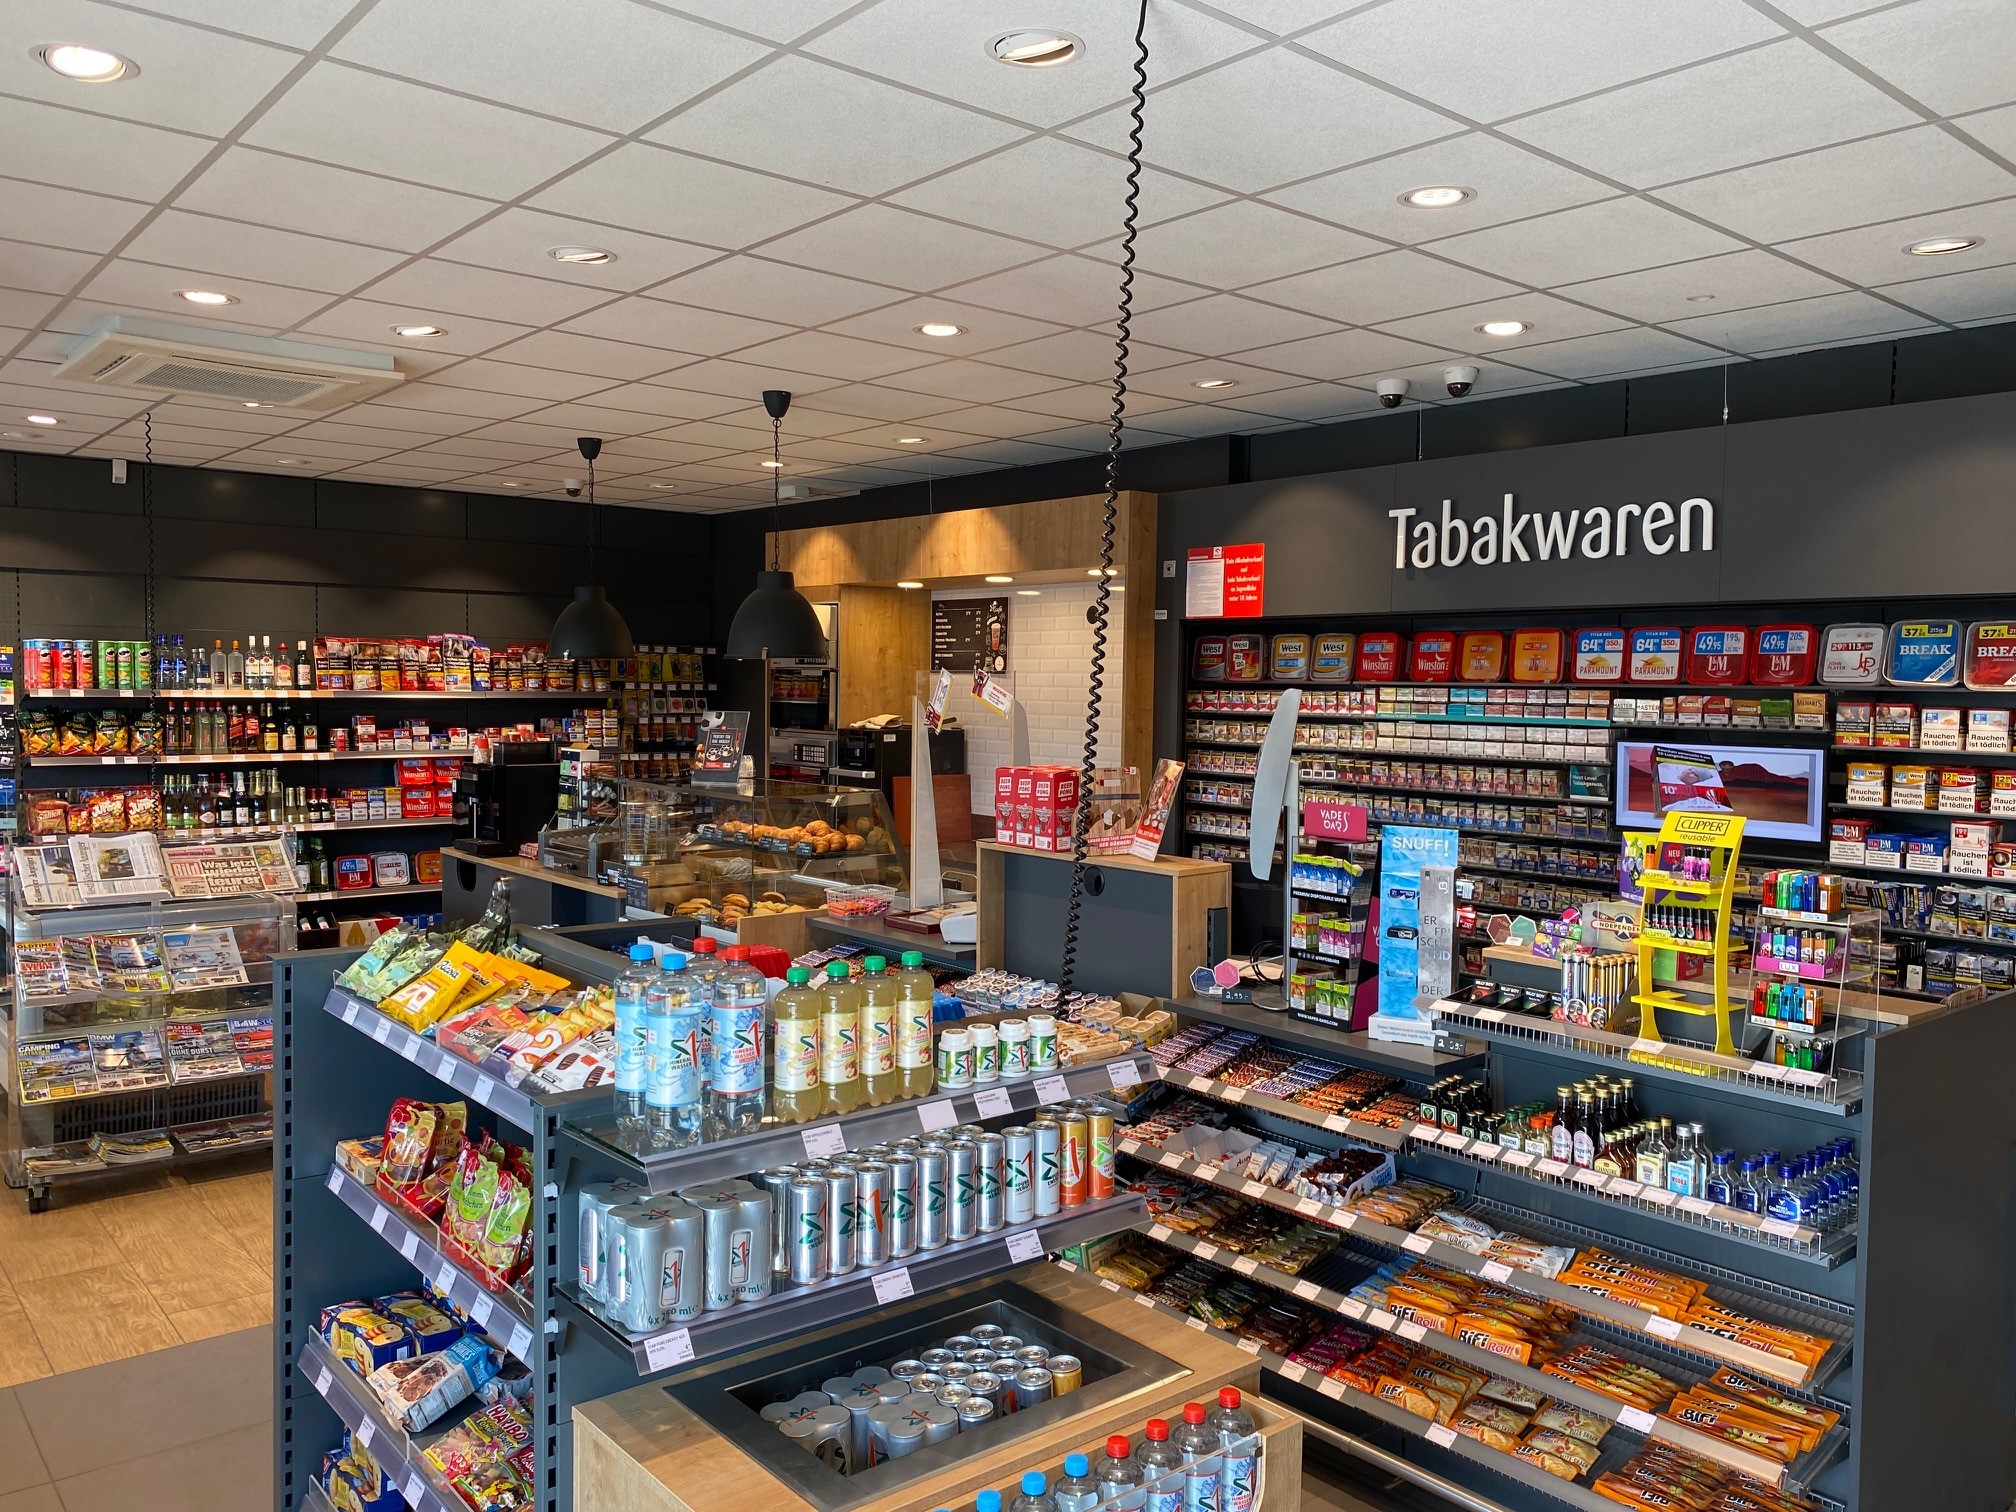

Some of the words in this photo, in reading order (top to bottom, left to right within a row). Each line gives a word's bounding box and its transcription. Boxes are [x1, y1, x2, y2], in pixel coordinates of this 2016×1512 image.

[1388, 493, 1714, 569] Tabakwaren
[1203, 645, 1221, 653] West
[1281, 643, 1302, 652] West
[1322, 643, 1344, 652] West
[1899, 644, 1952, 655] BREAK
[1362, 659, 1389, 670] Winston
[1418, 658, 1445, 670] Winston
[1707, 655, 1727, 671] L&M
[1771, 654, 1790, 671] L&M
[1580, 666, 1618, 675] PARAMOUNT
[1635, 666, 1674, 676] PARAMOUNT
[1929, 668, 1943, 680] GIGA
[1942, 658, 1954, 671] BOX
[1923, 732, 1956, 740] Rauchen
[1971, 734, 2005, 742] Rauchen
[1931, 739, 1957, 747] tödlich
[1979, 741, 2007, 749] tödlich
[403, 770, 427, 778] Winston
[437, 769, 461, 777] Winston
[1060, 781, 1073, 789] BEER
[1060, 788, 1073, 796] PONG
[1850, 788, 1881, 796] Rauchen
[1894, 791, 1922, 799] Rauchen
[1858, 795, 1882, 803] tödlich
[1901, 798, 1923, 806] tödlich
[1941, 794, 1972, 802] Rauchen
[406, 802, 429, 811] Winston
[1949, 801, 1974, 809] tödlich
[1681, 819, 1726, 832] CLIPPER
[1844, 825, 1859, 837] L&M
[1679, 833, 1716, 843] reusable
[1392, 837, 1449, 857] SNUFF!
[1951, 850, 1987, 859] Rauchen
[171, 862, 201, 876] Bild
[230, 860, 256, 869] jetzt
[1954, 866, 1982, 875] tödlich
[208, 876, 261, 887] teurer
[210, 885, 241, 893] wird!
[1293, 890, 1310, 898] PREMIUM
[1310, 893, 1334, 902] DISPOSABLE
[1780, 963, 1797, 972] LUX
[233, 1019, 258, 1028] BMW
[91, 1034, 115, 1042] BMW
[18, 1043, 60, 1053] CAMPING
[172, 1048, 190, 1056] OHNE
[191, 1047, 213, 1055] DURST
[732, 1047, 754, 1055] MINERAL
[734, 1051, 755, 1059] WASSER
[669, 1057, 691, 1066] MINERAL
[671, 1062, 692, 1070] WASSER
[1462, 1218, 1486, 1233] TURKEY
[1447, 1233, 1472, 1249] TURKEY
[1628, 1273, 1659, 1287] Roll
[717, 1293, 729, 1302] 4x
[731, 1287, 746, 1299] 250
[748, 1285, 760, 1294] ml
[648, 1315, 660, 1325] 4x
[661, 1308, 677, 1322] 250
[679, 1305, 692, 1315] ml
[1417, 1315, 1438, 1328] Roll
[1315, 1338, 1351, 1350] Balisto
[1458, 1329, 1490, 1347] BiFi
[1486, 1339, 1512, 1355] Roll
[1301, 1350, 1335, 1364] Balisto
[486, 1404, 529, 1442] HARIBO
